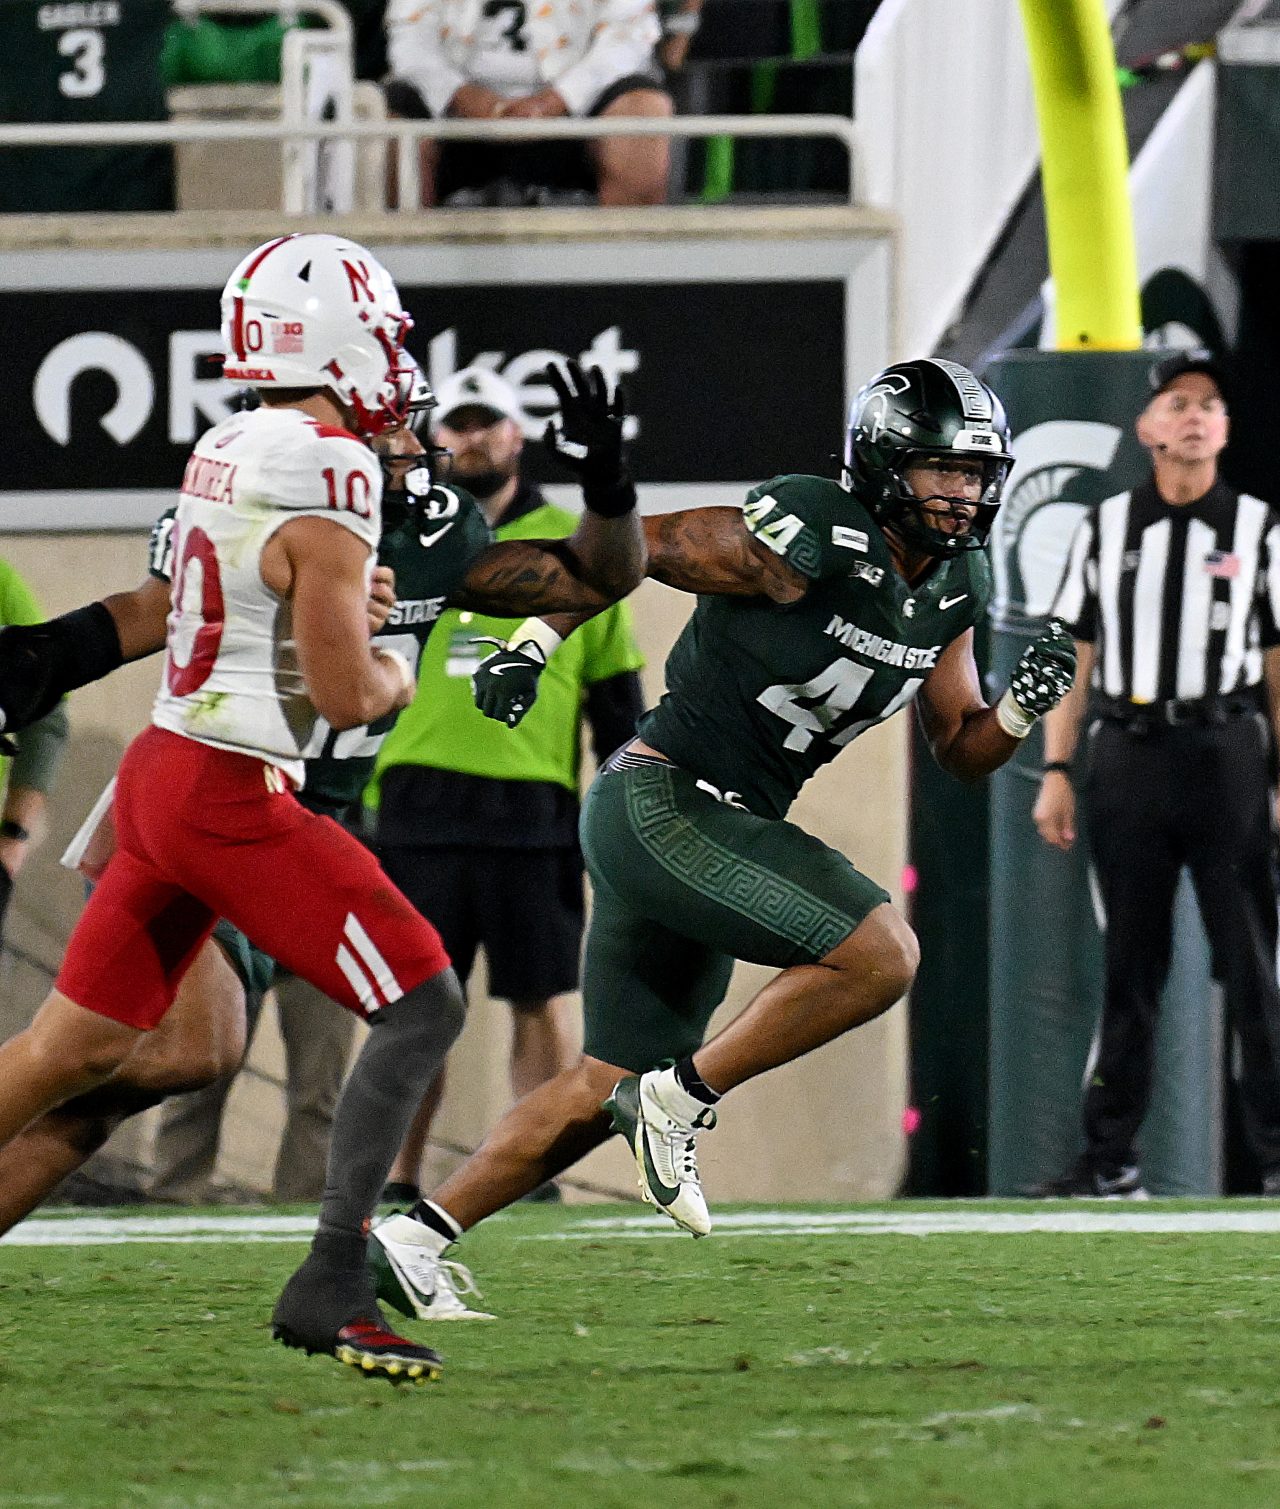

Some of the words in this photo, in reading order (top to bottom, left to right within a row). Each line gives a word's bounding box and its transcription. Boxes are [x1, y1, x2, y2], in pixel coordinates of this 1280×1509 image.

[58, 28, 106, 98] 3
[341, 259, 376, 303] N
[167, 325, 642, 446] Rket
[320, 467, 371, 519] 10
